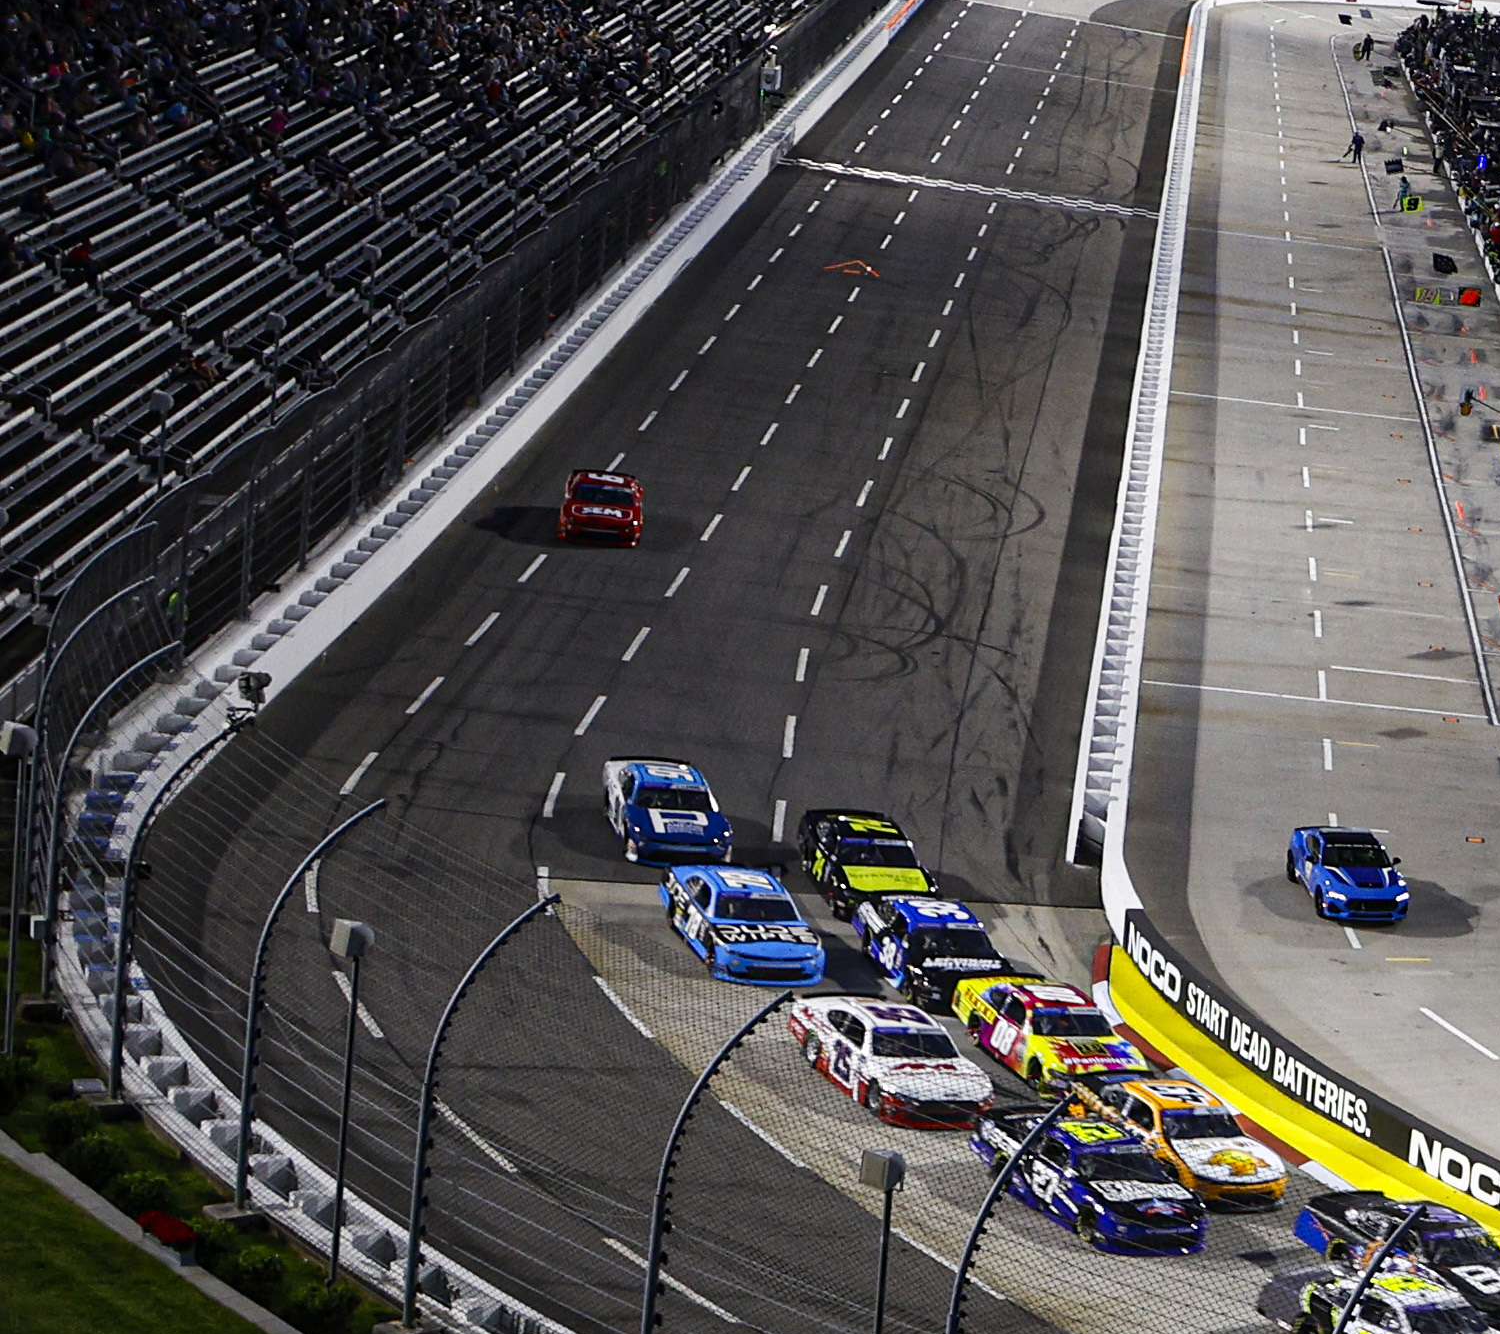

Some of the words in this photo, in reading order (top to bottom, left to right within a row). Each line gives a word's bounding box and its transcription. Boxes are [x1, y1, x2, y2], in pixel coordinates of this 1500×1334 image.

[580, 505, 622, 518] SEM
[881, 936, 899, 969] 38
[1127, 920, 1182, 1002] NOCO
[991, 1019, 1018, 1056] 08
[1186, 982, 1229, 1042] START
[1230, 1016, 1270, 1072] DEAD
[1272, 1052, 1372, 1138] BATTERIES.
